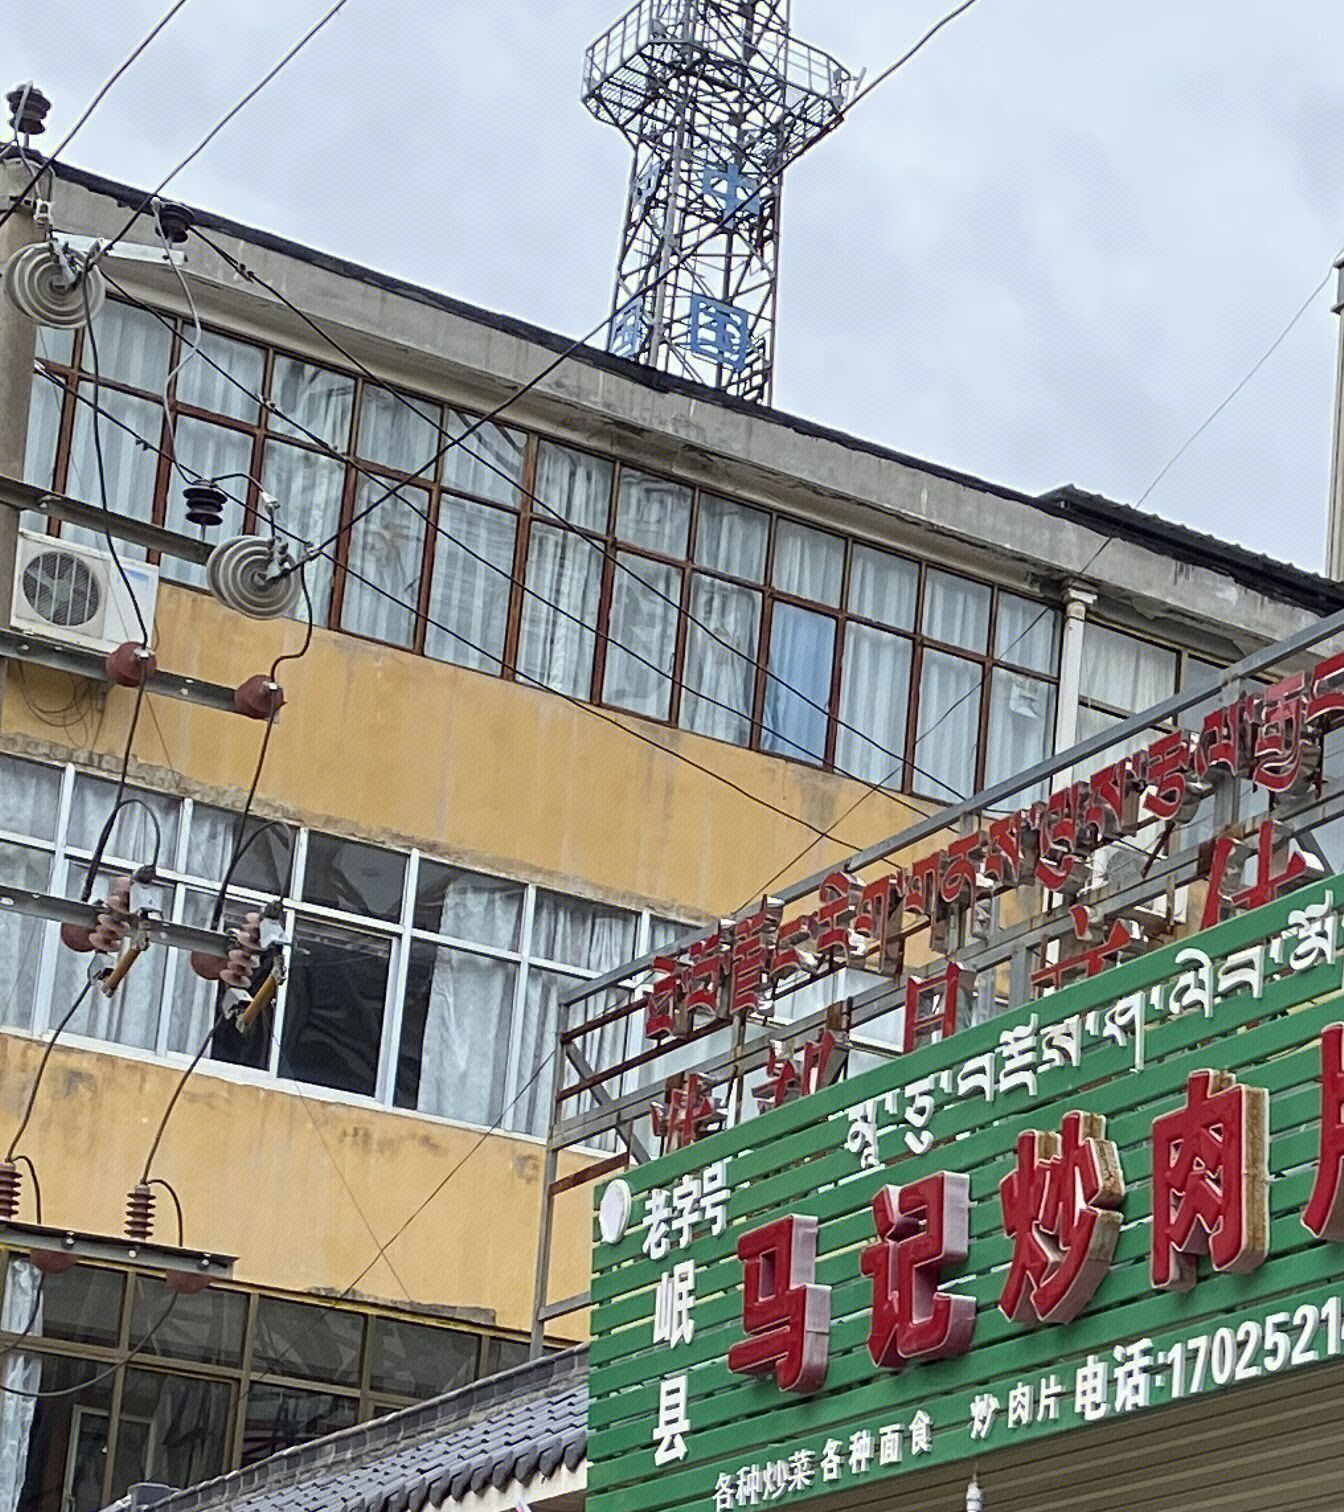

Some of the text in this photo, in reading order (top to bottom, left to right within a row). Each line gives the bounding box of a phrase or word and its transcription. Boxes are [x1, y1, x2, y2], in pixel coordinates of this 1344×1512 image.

[642, 1162, 731, 1260] 老字号
[652, 1259, 696, 1466] 岷县
